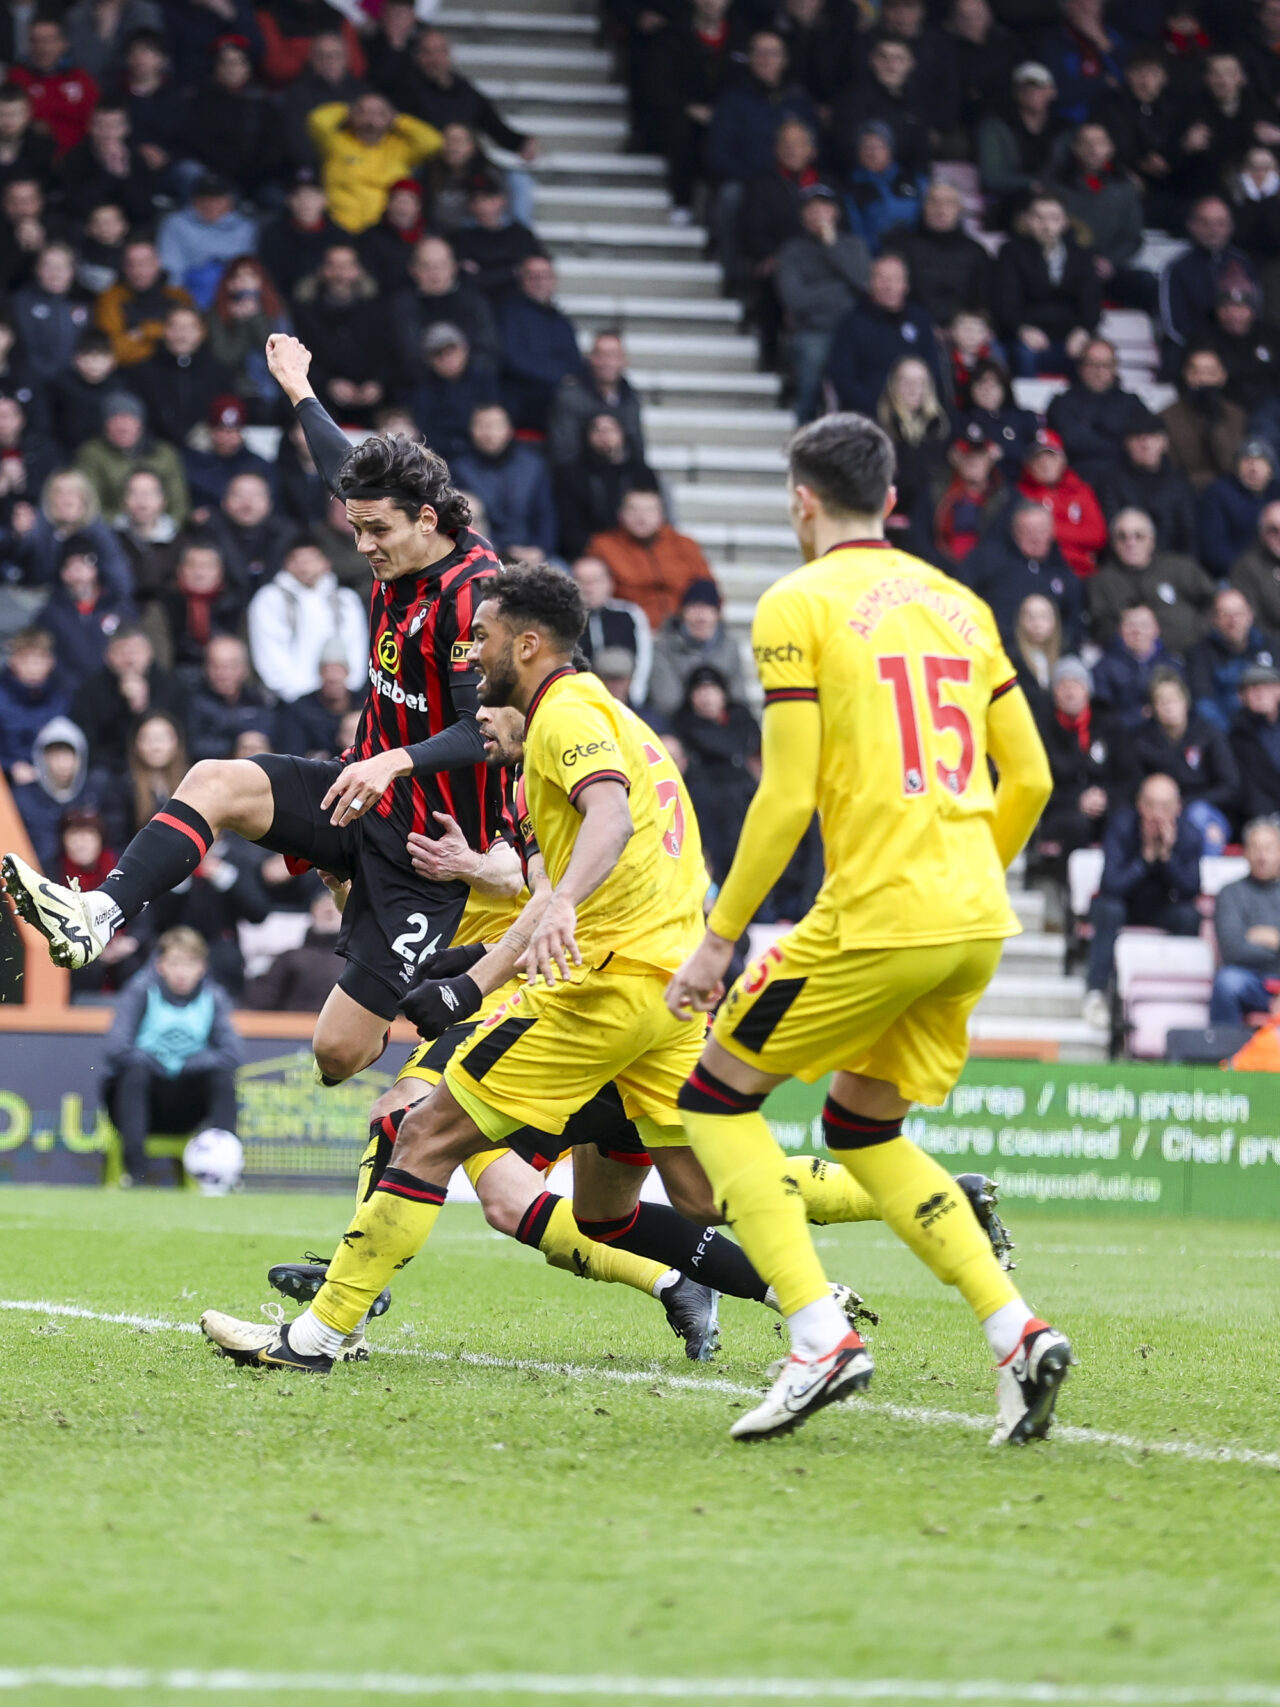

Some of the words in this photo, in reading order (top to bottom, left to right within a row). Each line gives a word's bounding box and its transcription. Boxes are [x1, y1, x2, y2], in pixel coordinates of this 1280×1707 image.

[877, 655, 974, 796] 15
[953, 1084, 1025, 1119] prep
[1067, 1082, 1136, 1123] High
[1139, 1088, 1250, 1124] protein
[998, 1123, 1121, 1160] counted
[1161, 1124, 1234, 1164] Chef
[691, 1226, 716, 1268] AFCB
